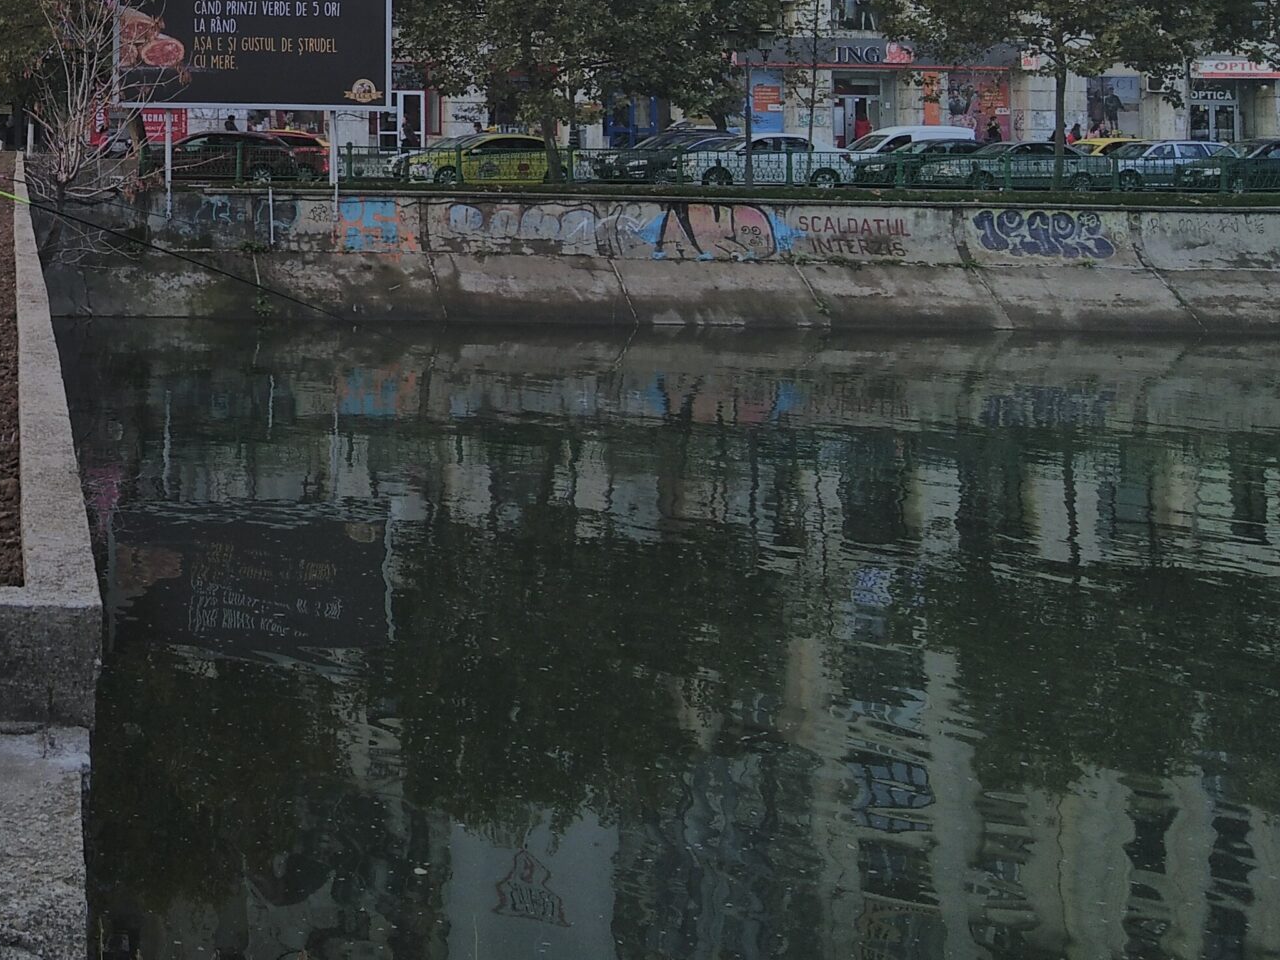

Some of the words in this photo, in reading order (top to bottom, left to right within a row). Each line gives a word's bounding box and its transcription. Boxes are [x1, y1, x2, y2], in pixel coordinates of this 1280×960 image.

[226, 0, 257, 15] PRINZI
[262, 0, 291, 16] VERDE
[296, 1, 308, 16] DE
[313, 1, 320, 16] 5
[324, 1, 341, 17] ORI
[194, 18, 206, 33] LA
[217, 37, 222, 51] E
[241, 37, 276, 52] GUSTUL
[281, 37, 293, 52] DE
[194, 54, 206, 69] CU
[210, 54, 239, 69] MERE.
[832, 45, 880, 64] ING
[798, 215, 911, 237] SCALDATUL
